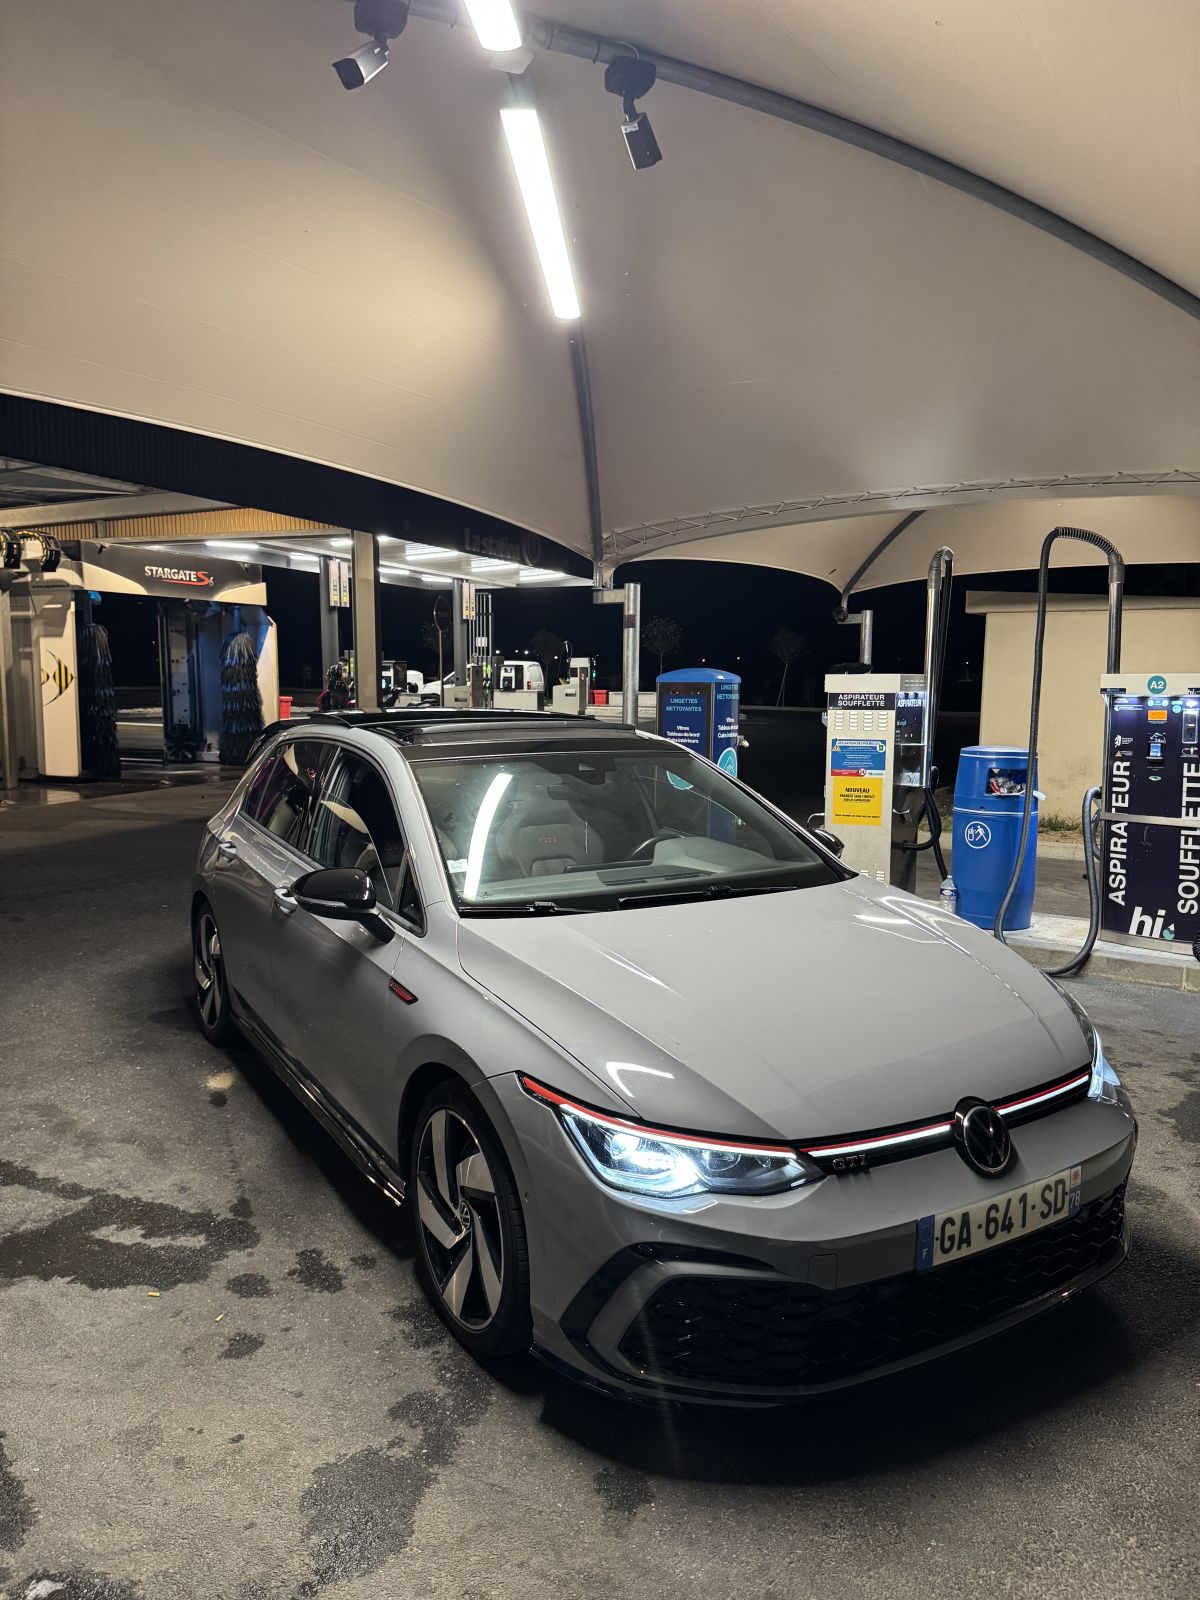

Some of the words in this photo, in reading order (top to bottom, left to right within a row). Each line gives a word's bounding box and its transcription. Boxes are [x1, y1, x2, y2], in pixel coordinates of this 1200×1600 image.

[1150, 680, 1165, 690] A2
[896, 698, 922, 708] ASPIRATEUR
[1176, 762, 1200, 915] SOUFFLETTE
[1069, 1190, 1081, 1209] 78
[939, 1177, 1067, 1255] GA-641-SD
[922, 1248, 928, 1260] F
